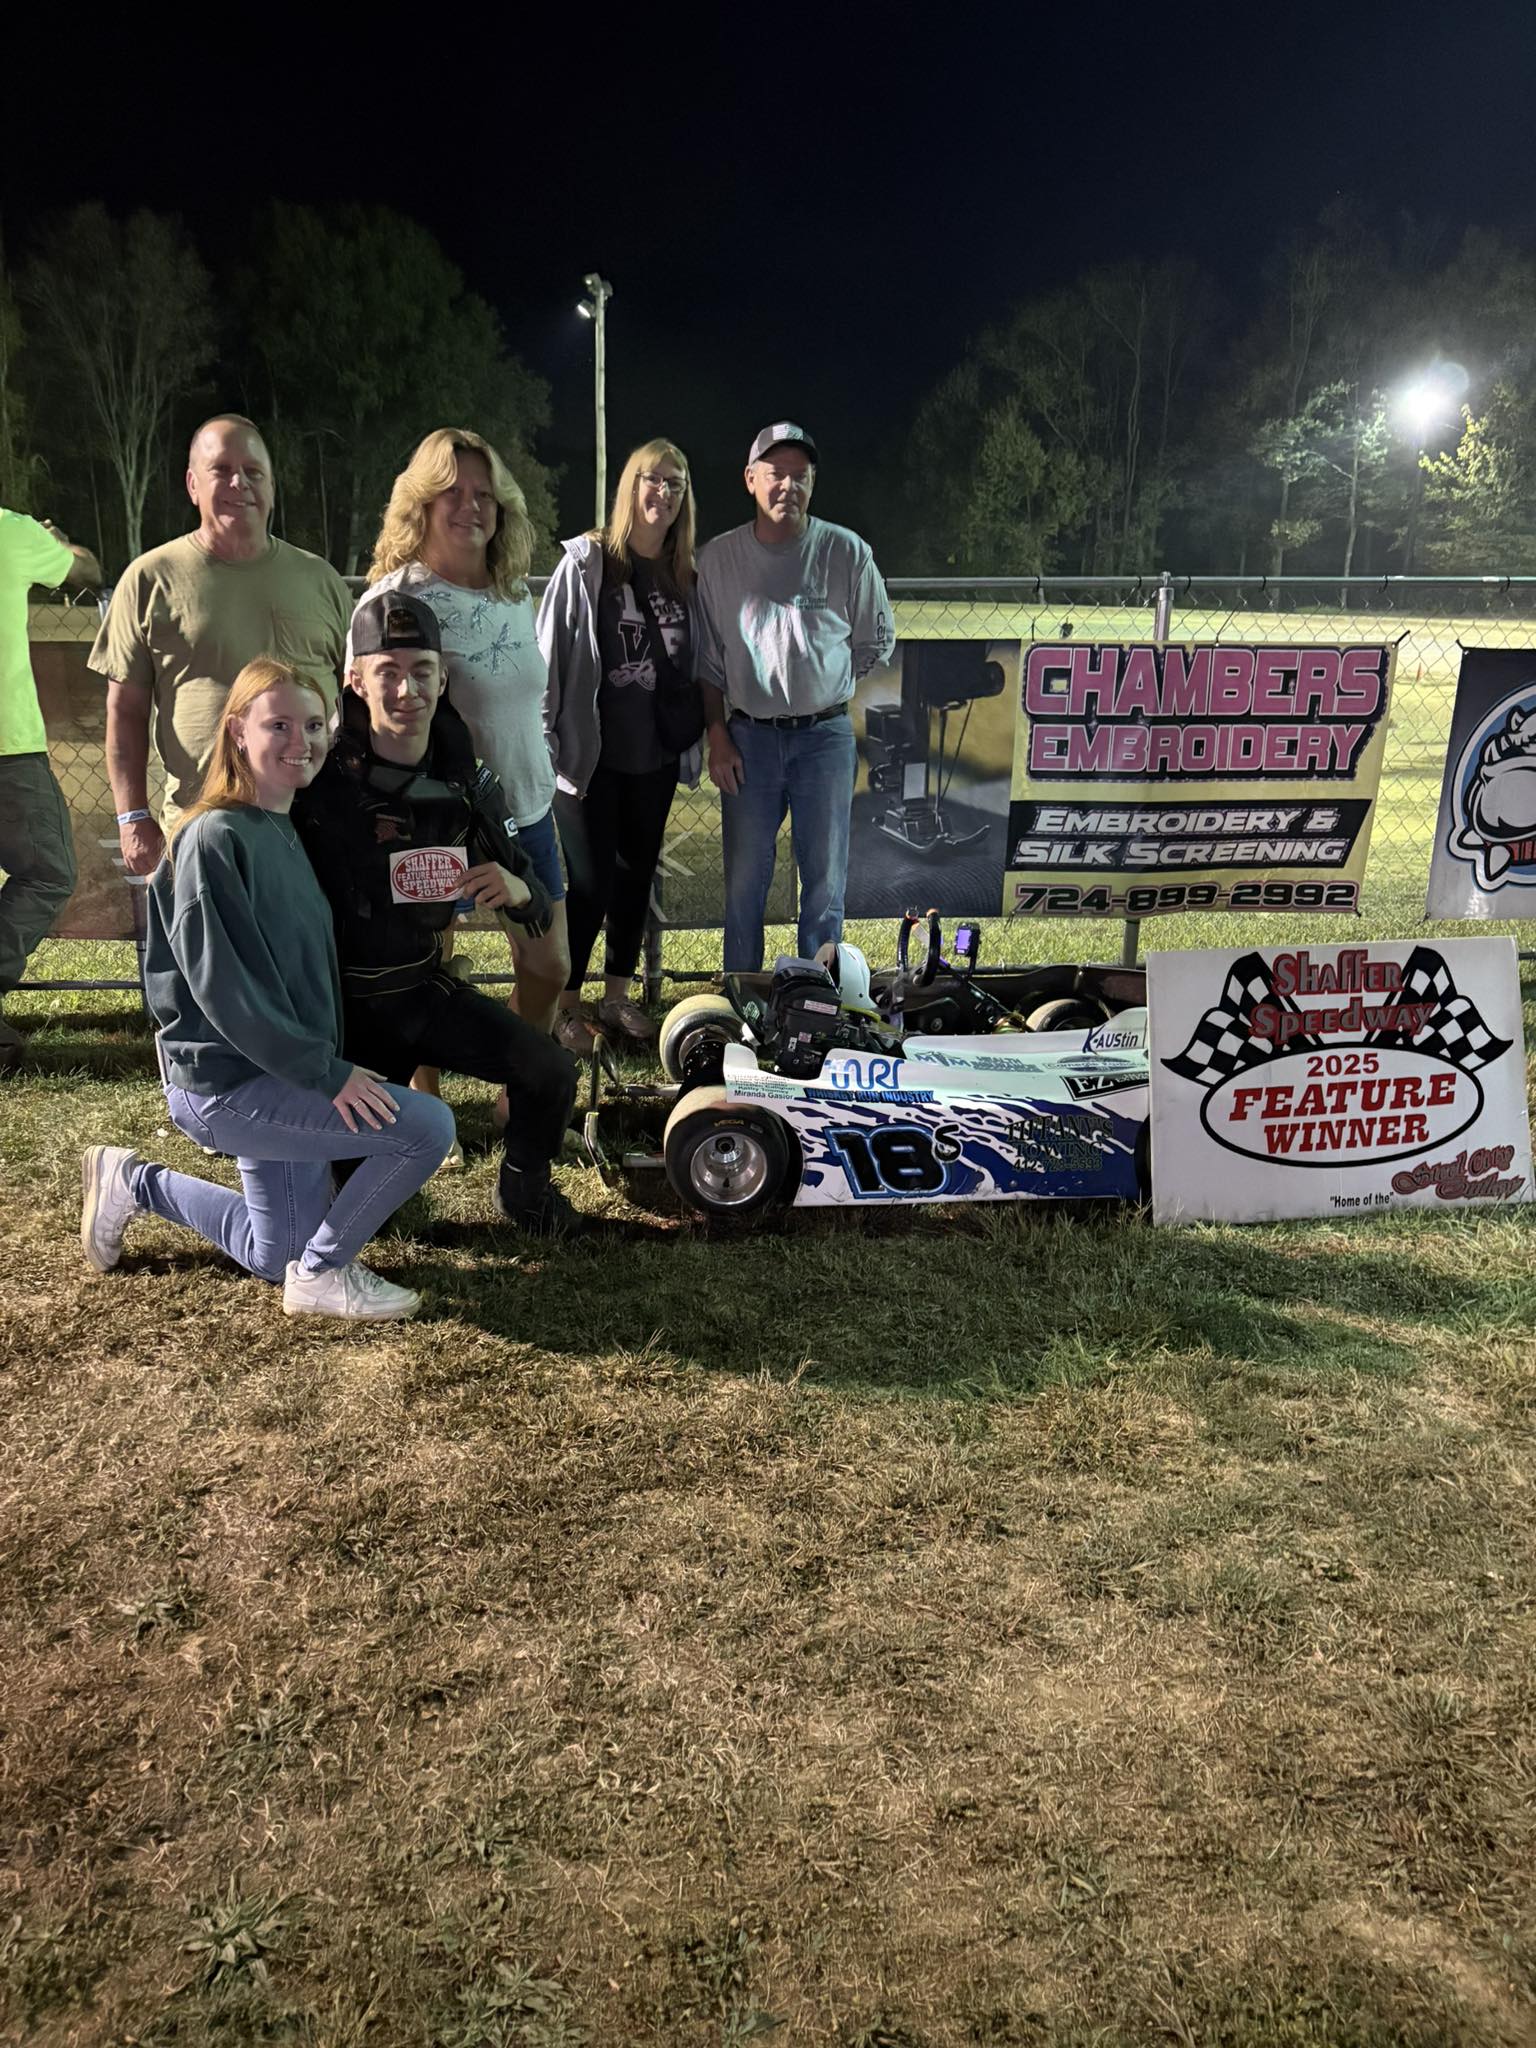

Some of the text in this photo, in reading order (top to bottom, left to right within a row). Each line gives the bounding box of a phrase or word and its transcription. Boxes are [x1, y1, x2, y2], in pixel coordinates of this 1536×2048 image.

[1024, 646, 1384, 718] CHAMBERS
[1030, 723, 1367, 773] EMBROIDERY
[1033, 808, 1339, 834] EMBROIDERY &
[404, 853, 453, 873] SHAFFER
[1014, 839, 1348, 865] SILK SCREENING
[397, 868, 461, 882] FEATURE WINNER
[417, 887, 446, 898] 2025
[1016, 883, 1358, 914] 724-899-2992
[1307, 1053, 1380, 1078] 2025
[734, 1089, 766, 1098] Miranda
[855, 1090, 880, 1103] RUN
[879, 1090, 934, 1103] INDUSTRY
[1229, 1072, 1458, 1122] FEATURE
[1263, 1113, 1430, 1155] WINNER
[1013, 1142, 1102, 1159] TOWING
[1364, 1193, 1374, 1206] of
